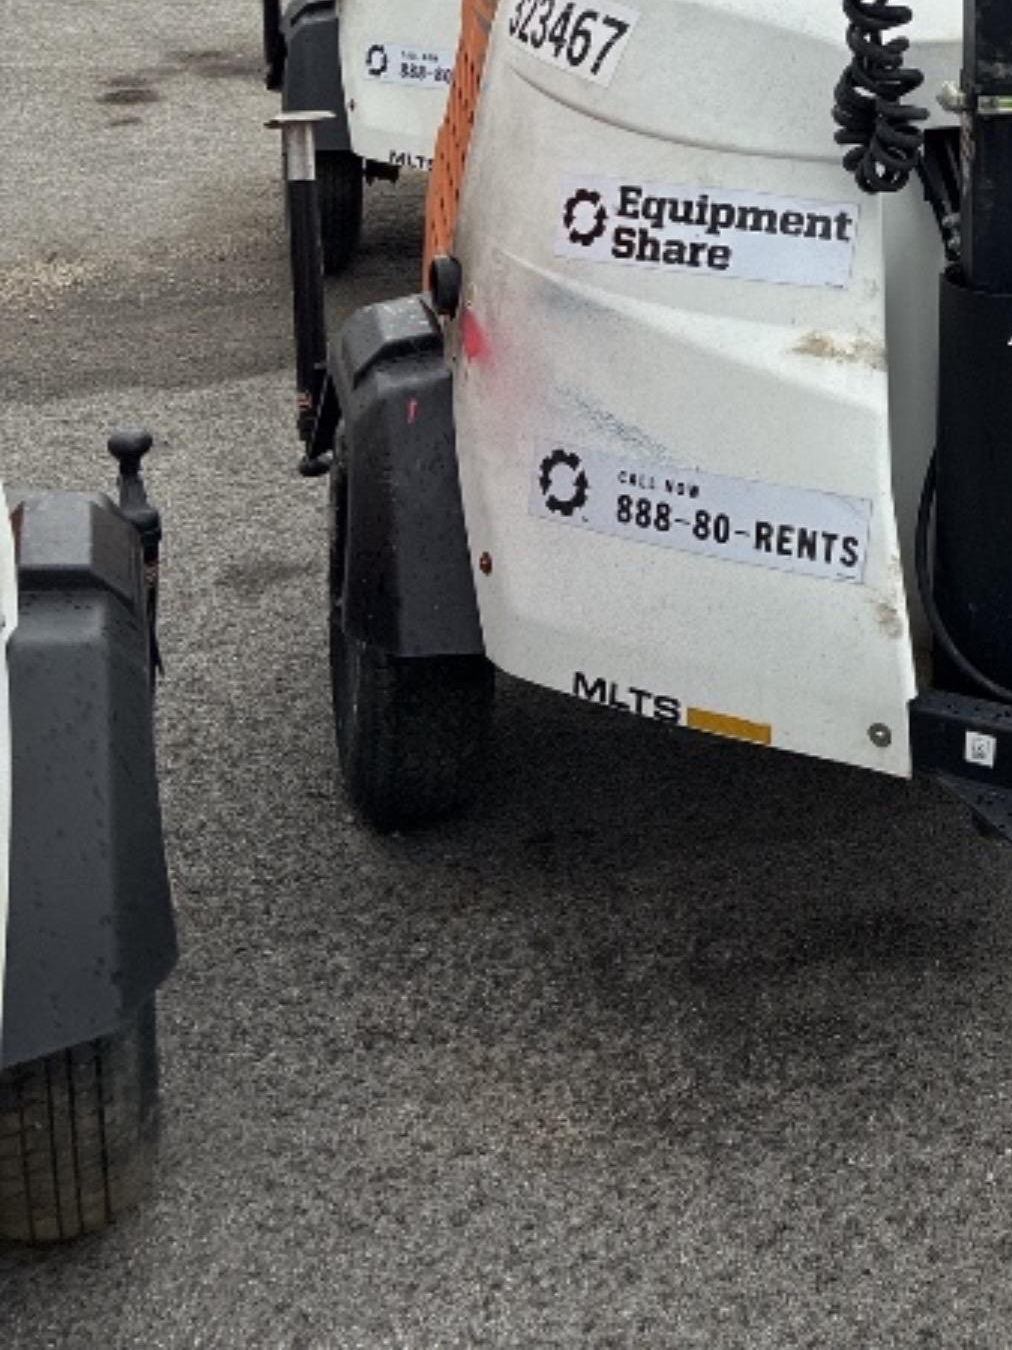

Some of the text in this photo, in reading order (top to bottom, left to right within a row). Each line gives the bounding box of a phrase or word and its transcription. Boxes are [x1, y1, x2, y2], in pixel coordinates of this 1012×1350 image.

[615, 185, 853, 241] Equipment
[612, 227, 733, 271] Share
[617, 470, 656, 490] CALL
[616, 494, 860, 568] 888-80-RENTS
[572, 671, 682, 725] MLTS
